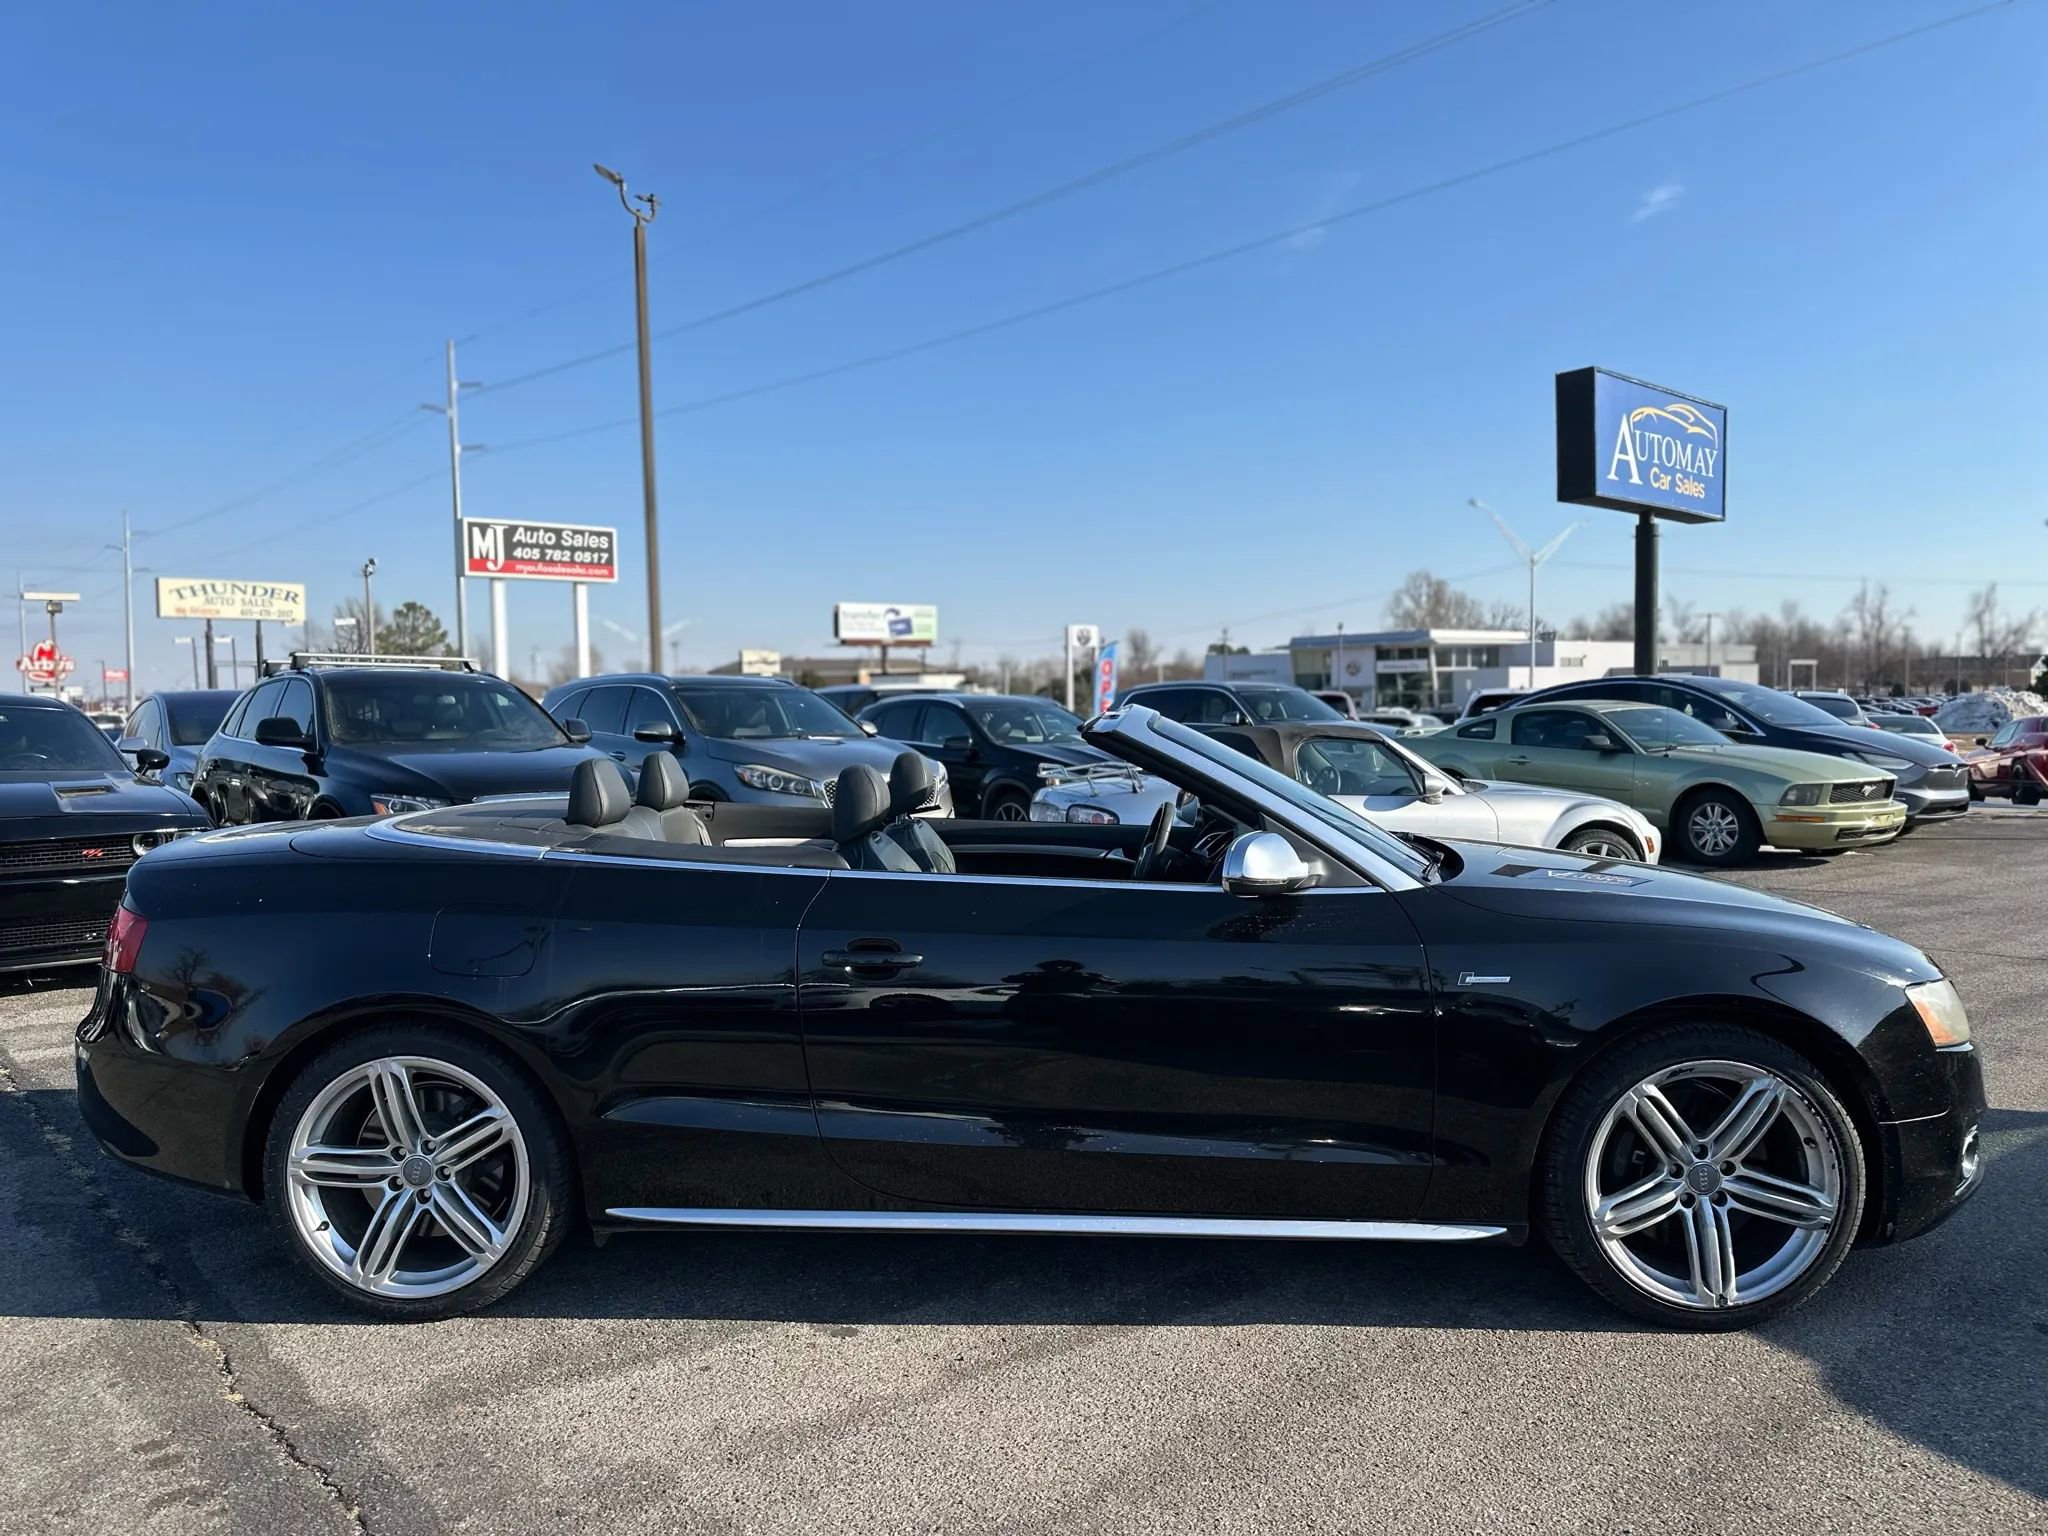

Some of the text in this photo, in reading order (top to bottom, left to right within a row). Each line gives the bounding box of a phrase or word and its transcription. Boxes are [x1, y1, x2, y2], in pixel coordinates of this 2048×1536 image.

[1606, 413, 1718, 485] AUTOMAY
[1650, 467, 1705, 499] Car Sales
[471, 525, 509, 571] MJ
[512, 527, 609, 549] Auto Sales
[513, 547, 609, 564] 405 782 0517
[169, 583, 300, 605] THUNDER
[203, 596, 274, 608] AUTO SALES
